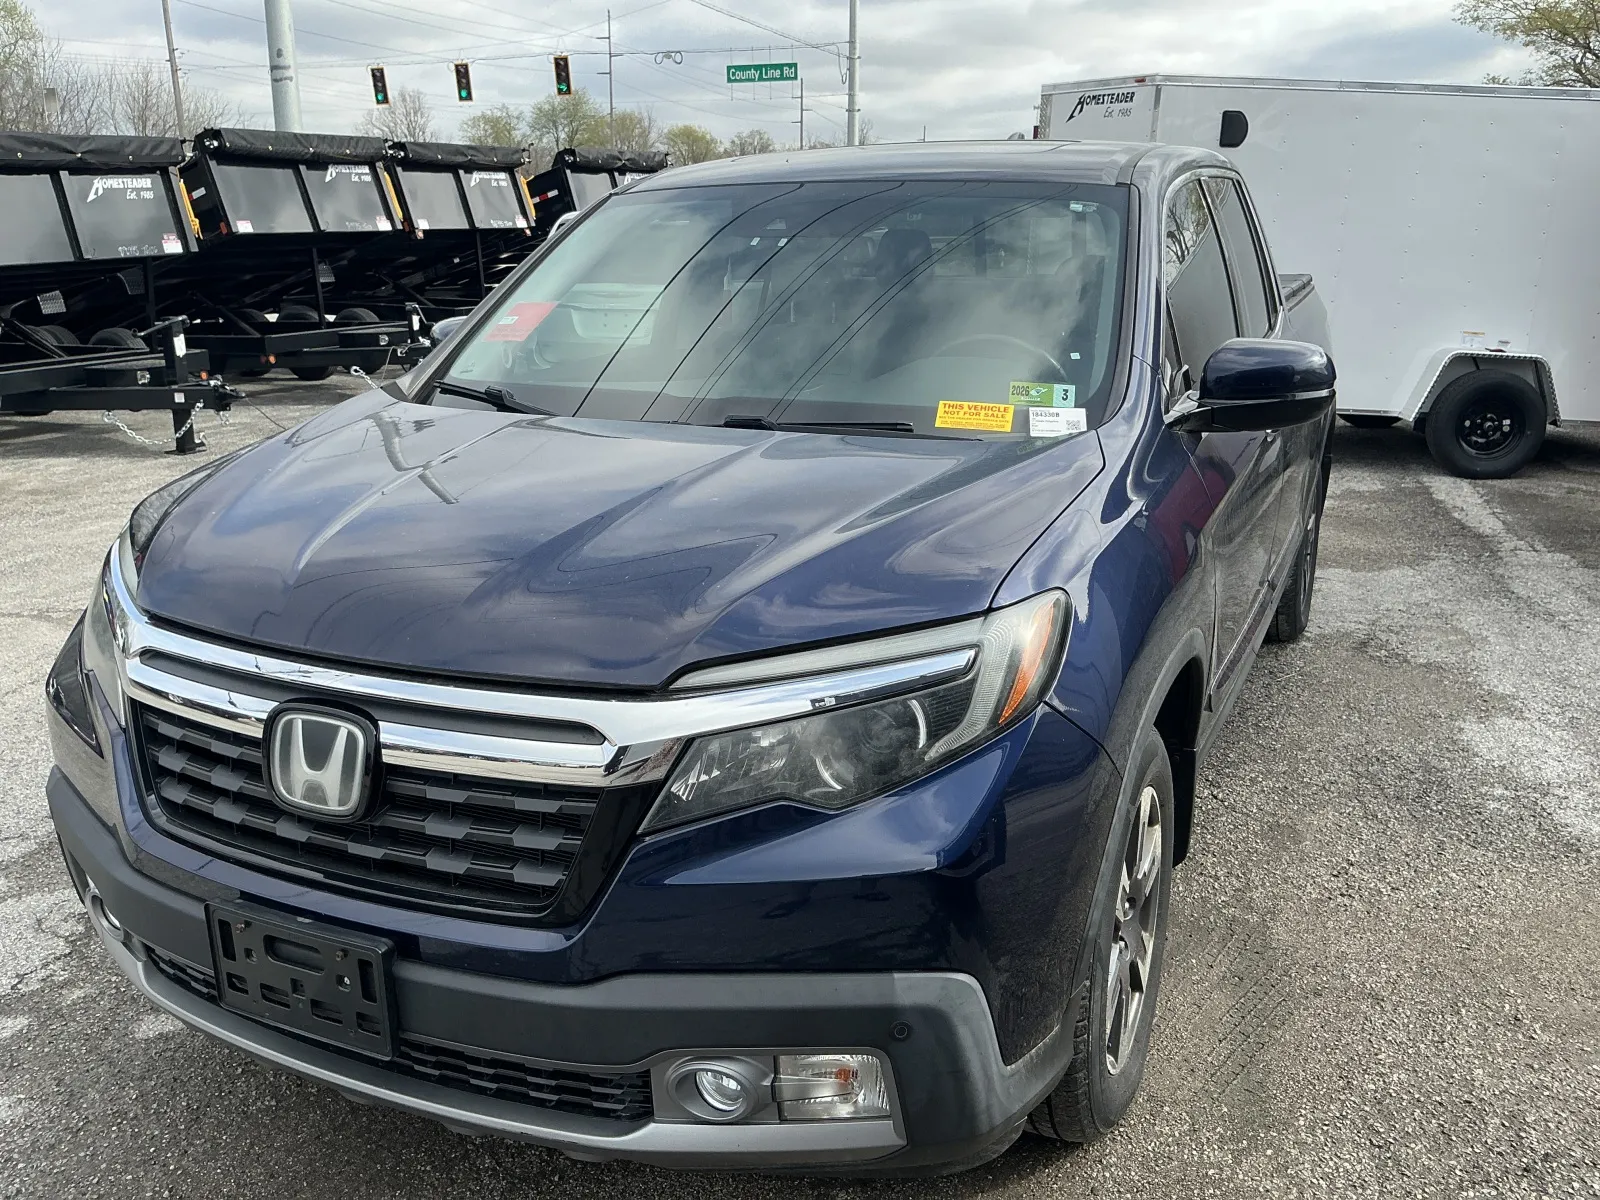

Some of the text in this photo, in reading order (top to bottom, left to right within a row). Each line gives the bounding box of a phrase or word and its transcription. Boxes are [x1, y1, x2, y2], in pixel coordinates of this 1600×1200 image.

[729, 66, 795, 81] County Line Rd
[1065, 92, 1135, 123] HOMESTEADER
[86, 176, 152, 203] HOMESTEADER
[140, 190, 154, 200] 1985
[1011, 385, 1030, 396] 2026
[1061, 388, 1069, 401] 3
[942, 402, 1010, 413] THIS VEHICLE
